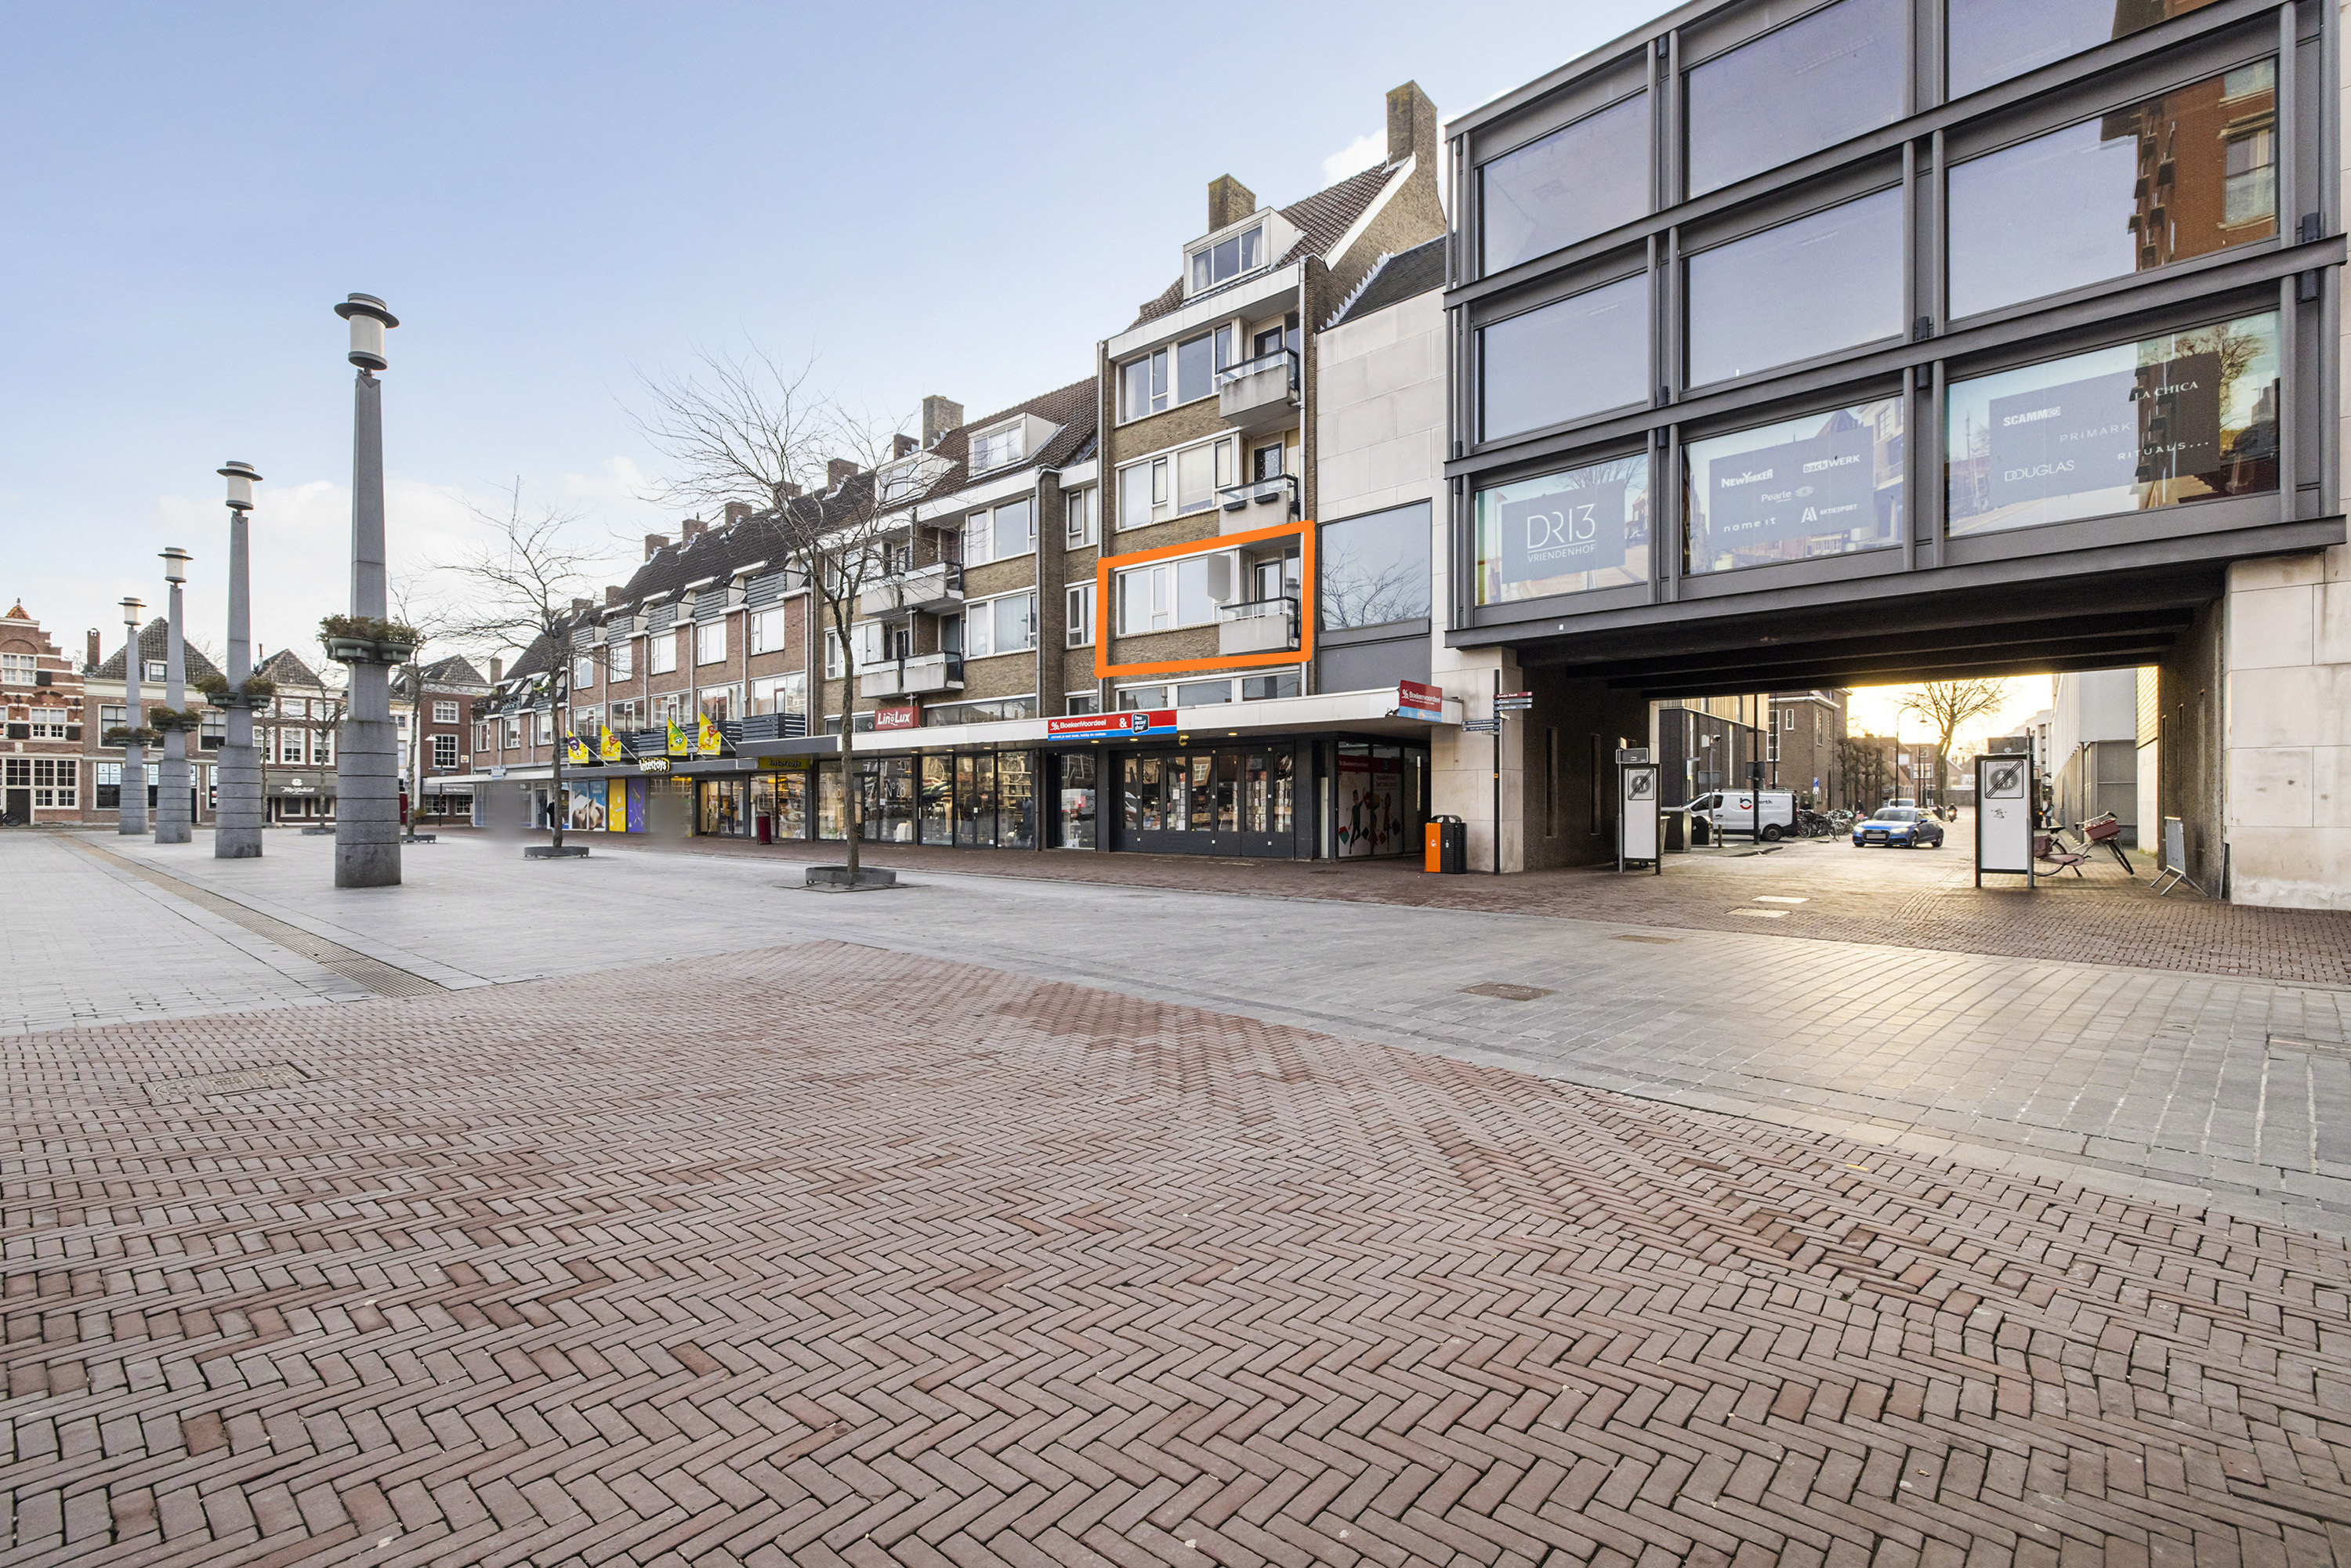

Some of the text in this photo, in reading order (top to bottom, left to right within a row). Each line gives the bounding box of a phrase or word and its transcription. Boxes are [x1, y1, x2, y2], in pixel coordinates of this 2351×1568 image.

[2135, 381, 2199, 401] LA CHICA
[2059, 422, 2131, 444] PRIMARK
[2005, 460, 2075, 482] DOUGLAS
[1761, 491, 1791, 502] Pearle
[1820, 504, 1858, 515] AKTIESPORT
[1527, 544, 1596, 563] VRIENDENHOF
[1060, 717, 1128, 729] BoekenVoordeel &
[770, 758, 802, 768] Intertoys
